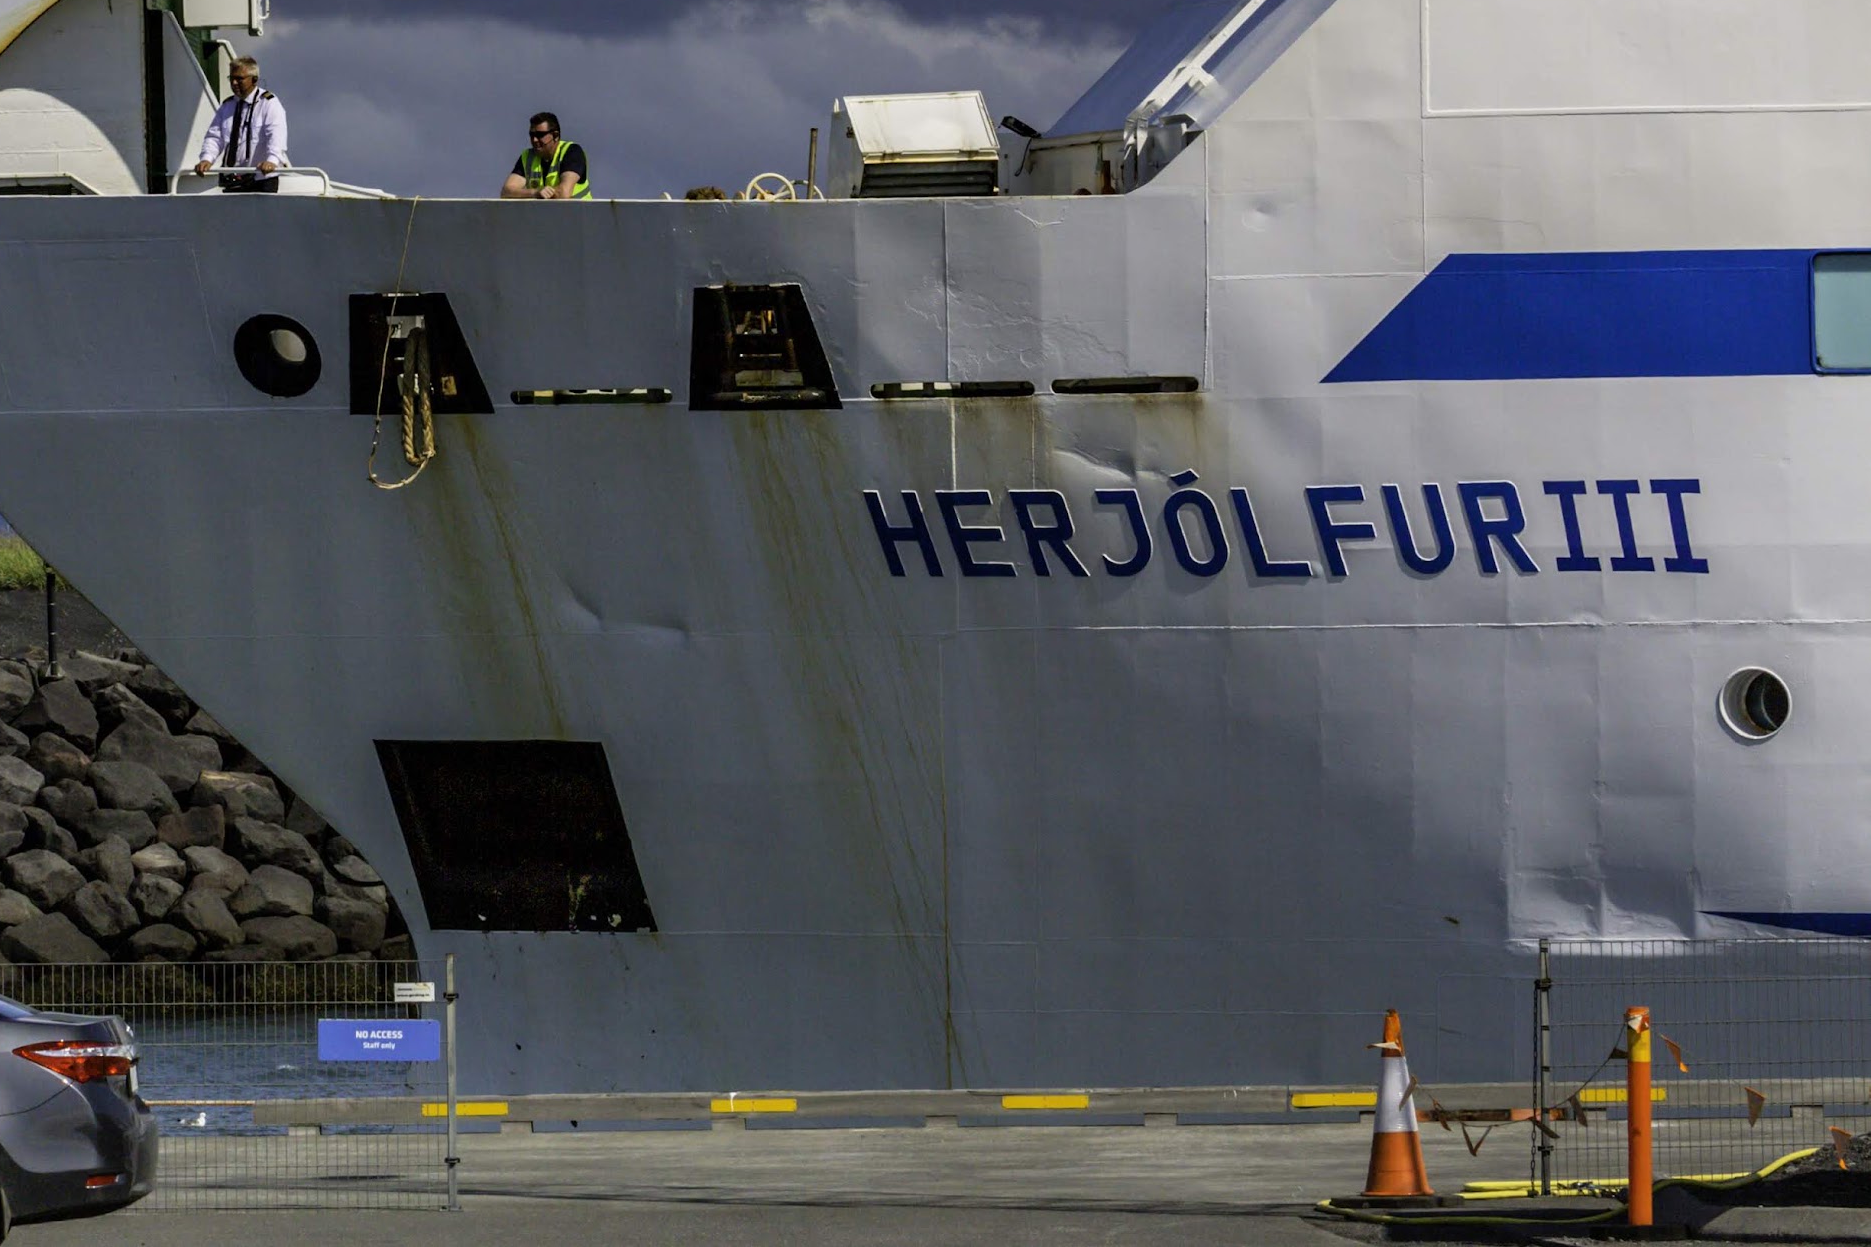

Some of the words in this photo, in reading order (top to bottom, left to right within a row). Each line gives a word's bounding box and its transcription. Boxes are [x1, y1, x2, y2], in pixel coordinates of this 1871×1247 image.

[355, 1030, 369, 1039] NO
[370, 1030, 404, 1039] ACCESS
[380, 1041, 396, 1050] only
